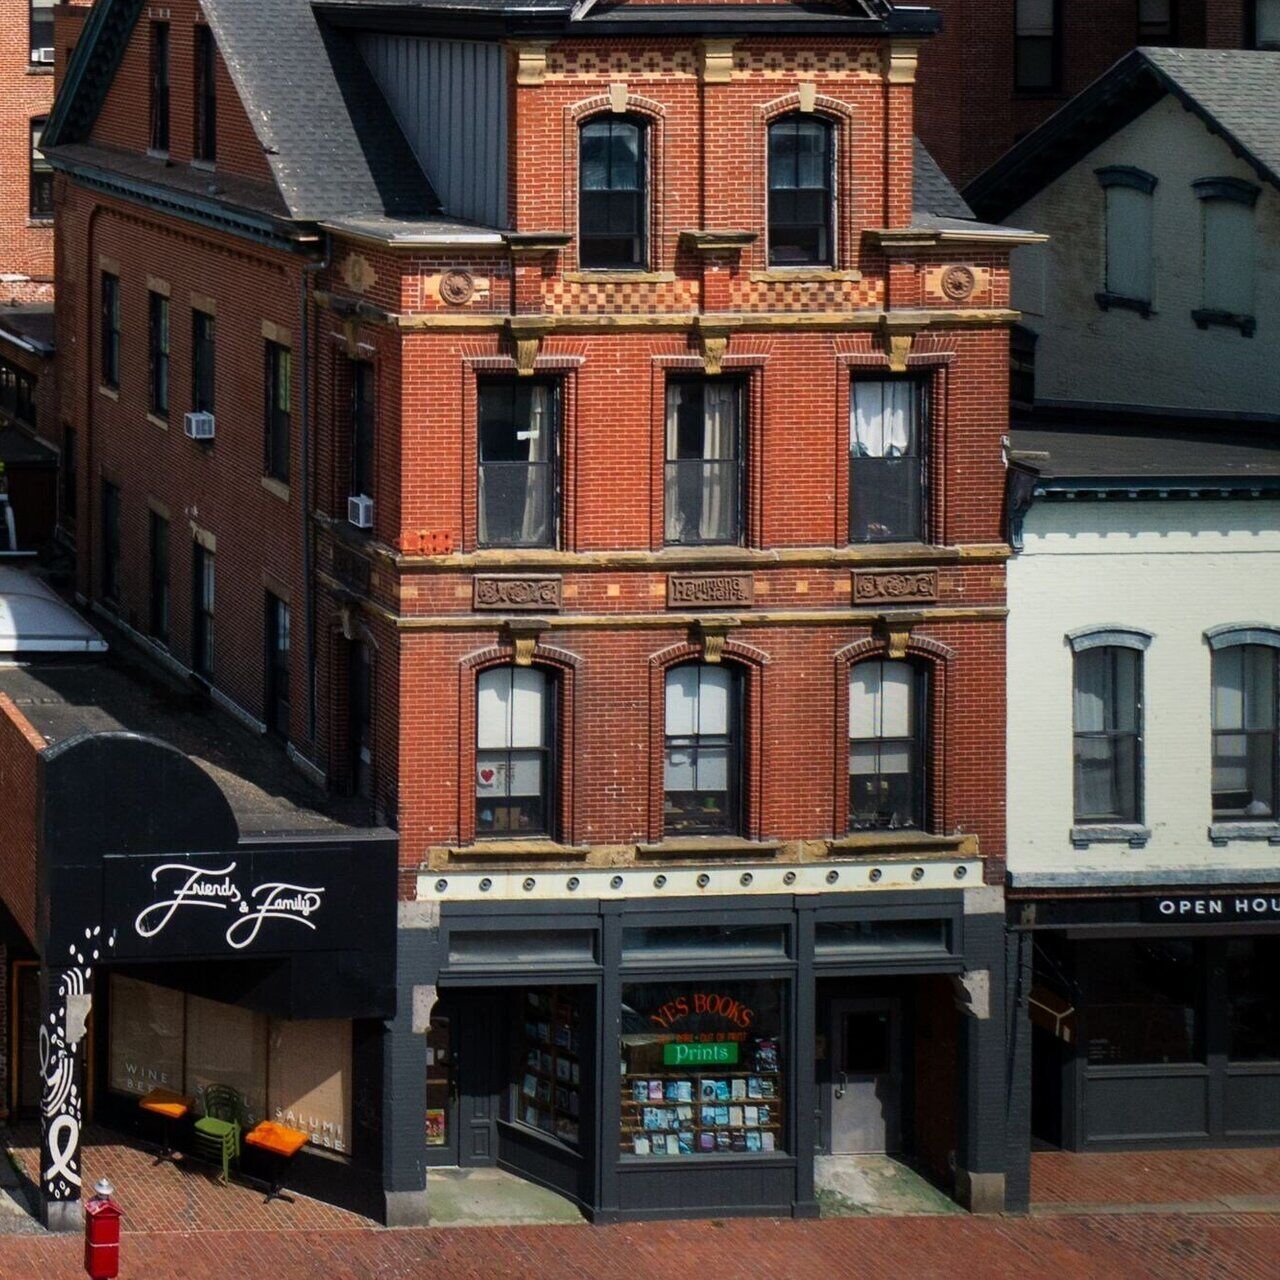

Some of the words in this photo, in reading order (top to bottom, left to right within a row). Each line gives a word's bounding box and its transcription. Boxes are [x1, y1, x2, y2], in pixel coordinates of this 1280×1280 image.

[135, 861, 242, 937] Friends
[239, 901, 249, 913] &
[1160, 900, 1222, 914] OPEN
[226, 882, 326, 949] Family
[650, 996, 690, 1028] YES
[693, 993, 755, 1028] BOOKS
[676, 1044, 729, 1065] Prints
[125, 1061, 169, 1084] WINE
[128, 1078, 156, 1093] BEE
[275, 1106, 343, 1135] SALUMI
